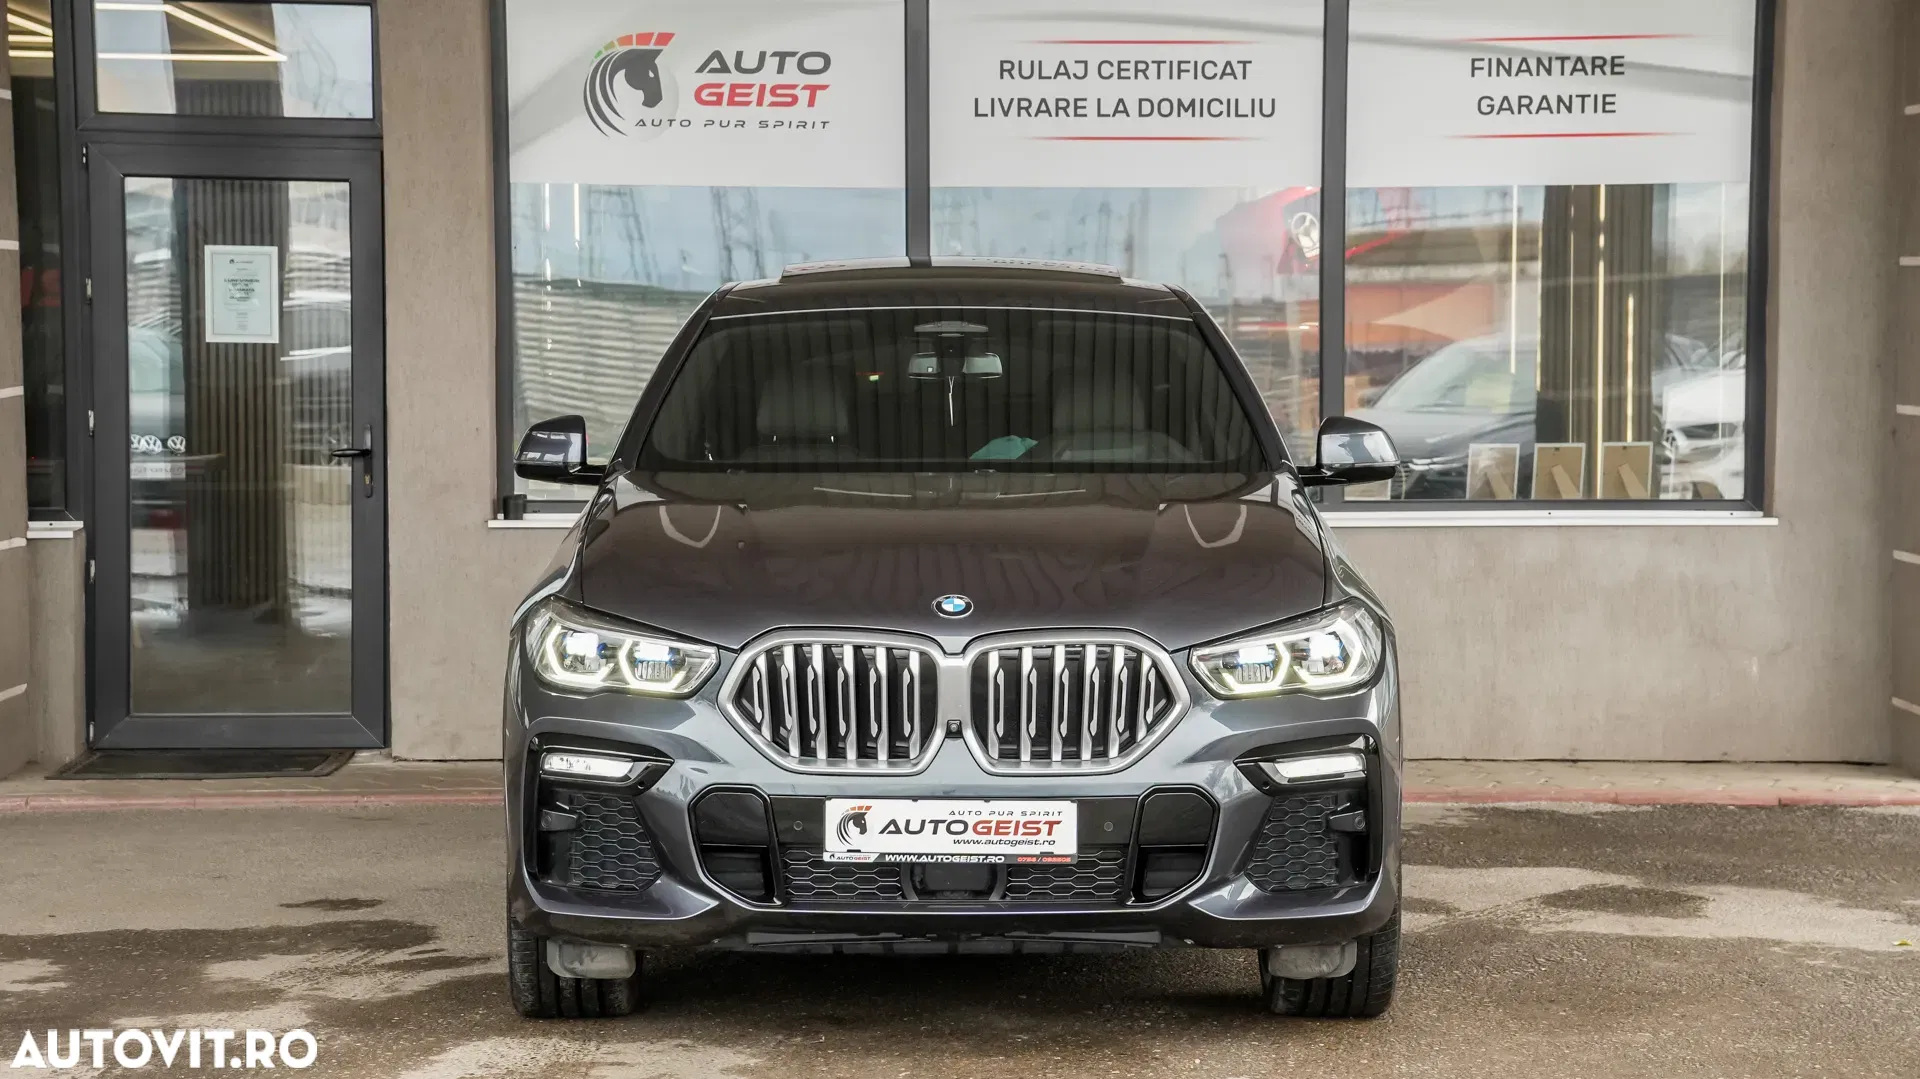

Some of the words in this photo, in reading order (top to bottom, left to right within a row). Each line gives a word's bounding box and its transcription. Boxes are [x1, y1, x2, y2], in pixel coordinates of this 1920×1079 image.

[694, 50, 832, 76] AUTO
[999, 59, 1089, 80] RULAJ
[1097, 59, 1253, 81] CERTIFICAT
[1470, 55, 1625, 78] FINANTARE
[693, 83, 831, 108] GEIST
[1477, 93, 1617, 116] GARANTIE
[974, 97, 1088, 118] LIVRARE
[1096, 97, 1131, 118] LA
[1138, 97, 1276, 118] DOMICILIU
[634, 118, 692, 128] AUTO
[703, 119, 746, 129] PUR
[758, 120, 831, 130] SPIRIT
[878, 819, 1062, 836] AUTOGEIST
[953, 838, 1056, 848] www.autogeist.ro
[885, 854, 1005, 863] WWW.AUTOGEIST.RO
